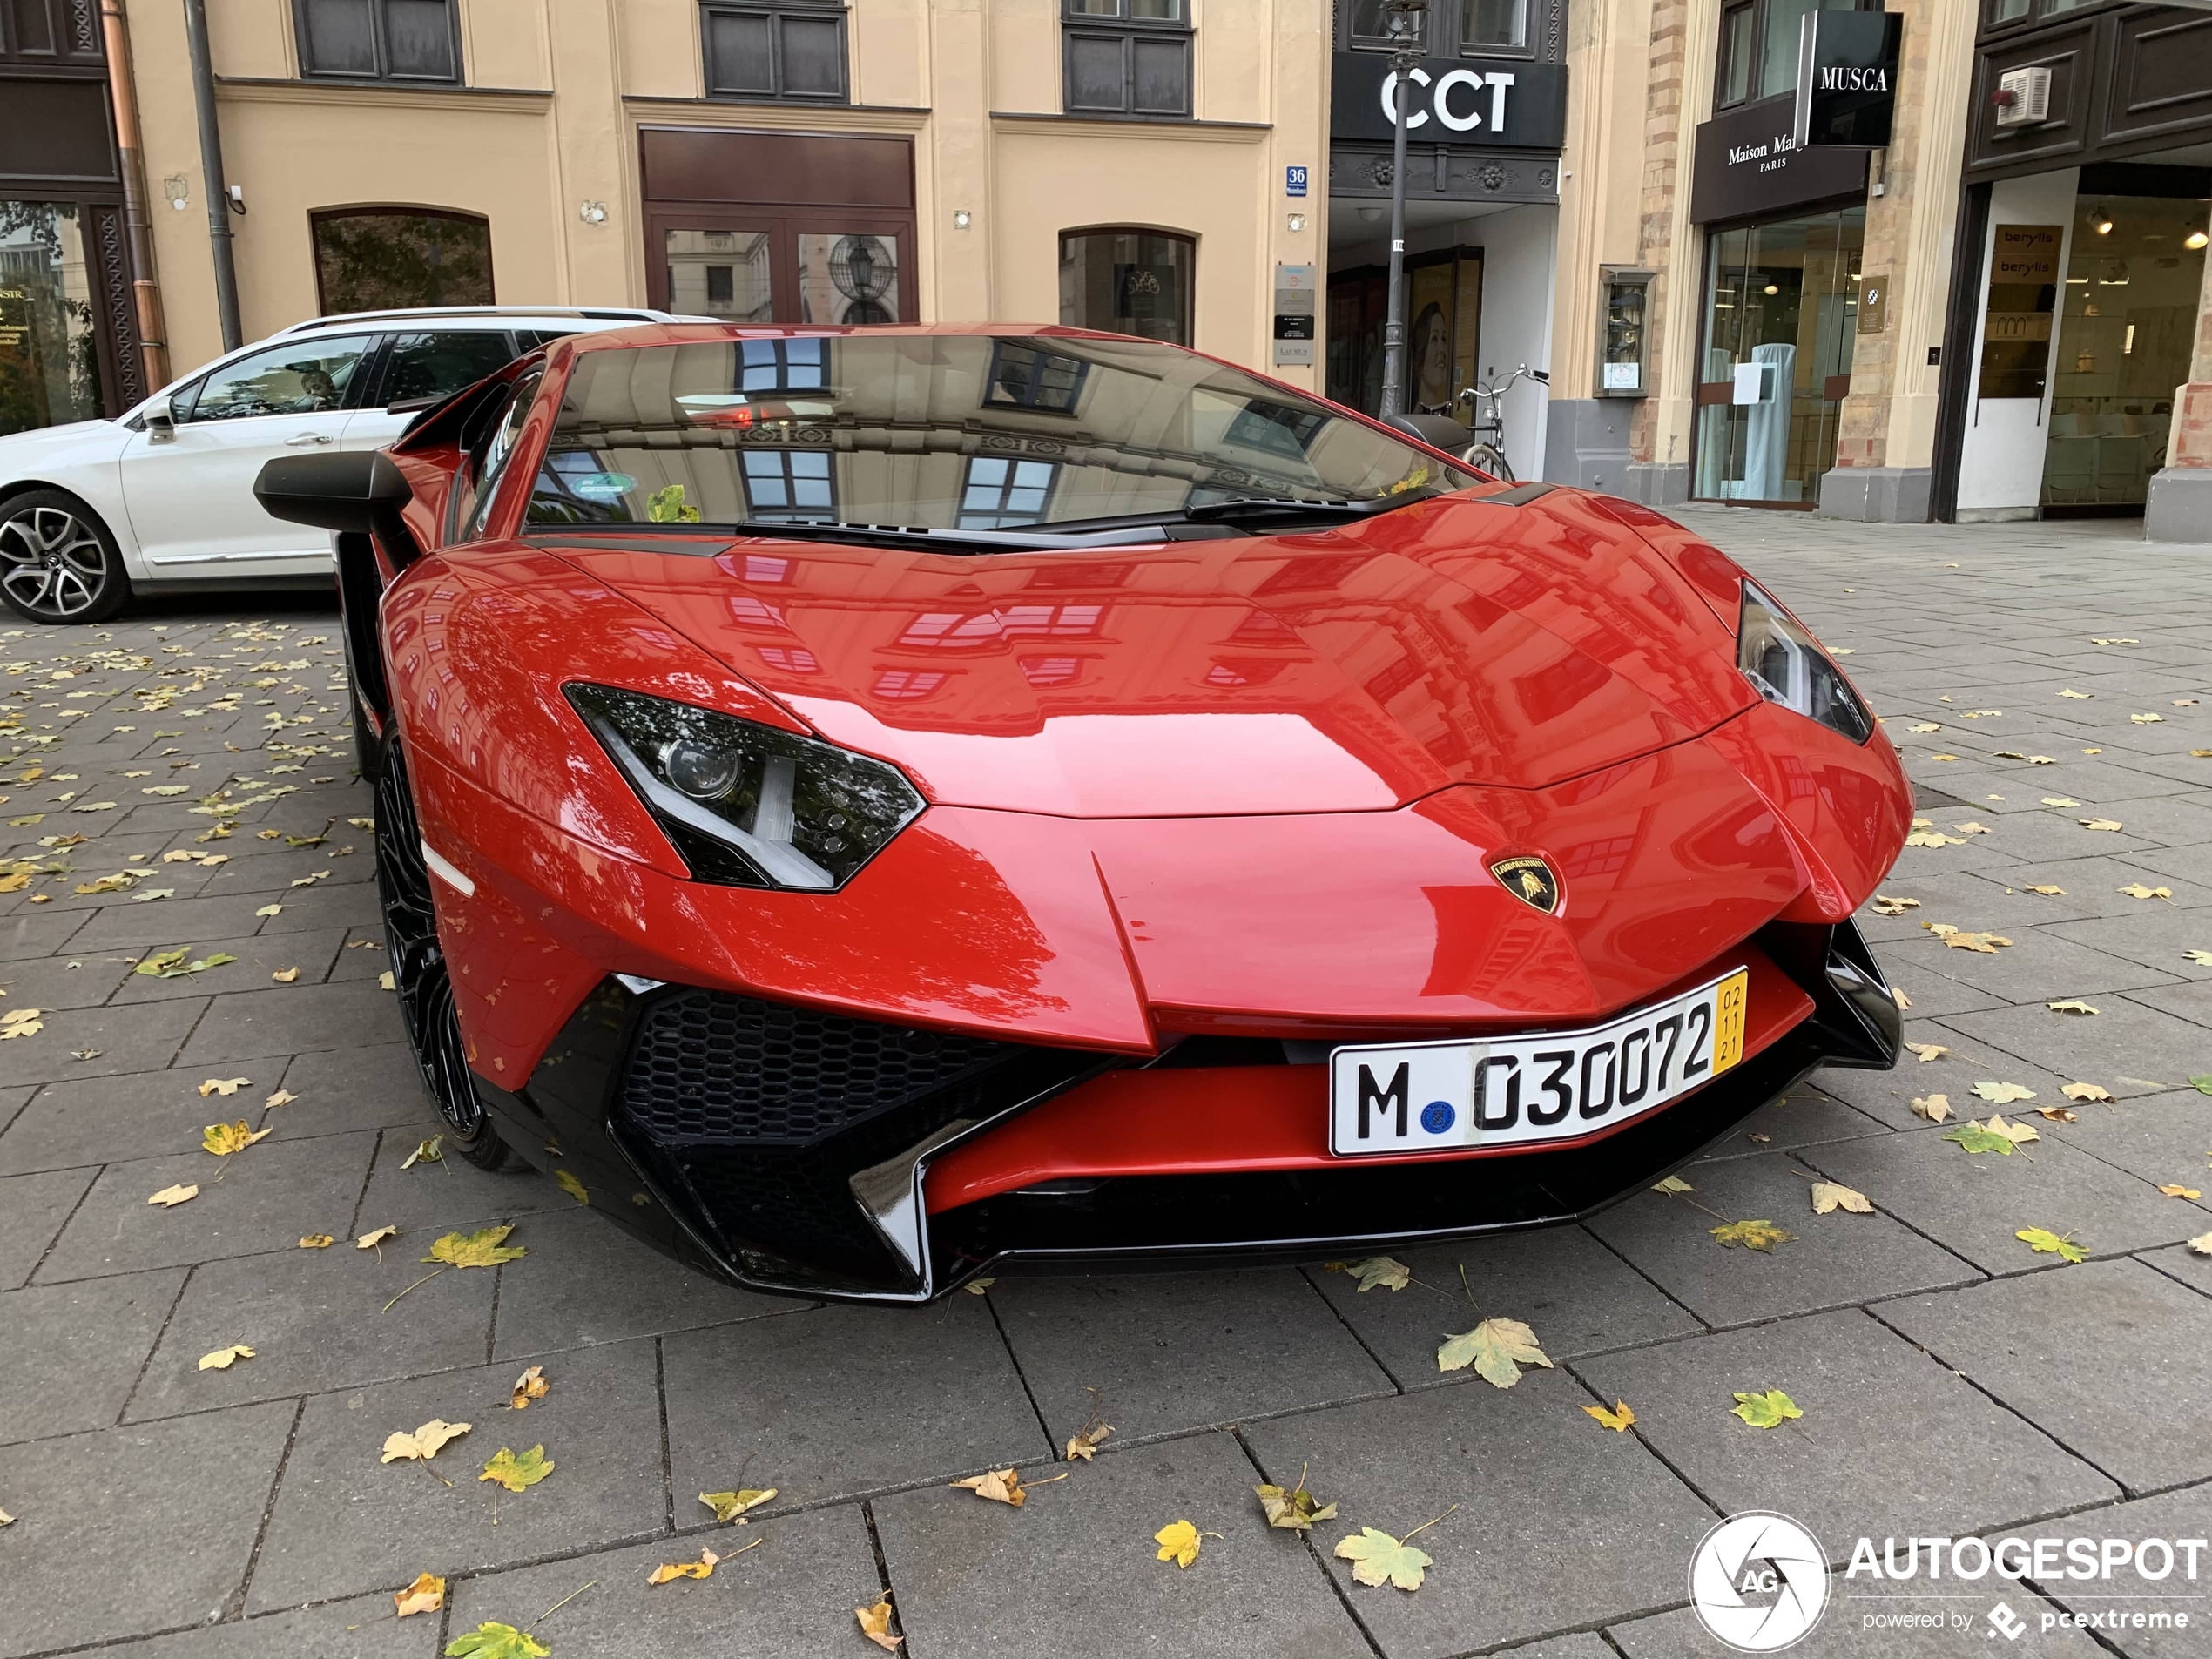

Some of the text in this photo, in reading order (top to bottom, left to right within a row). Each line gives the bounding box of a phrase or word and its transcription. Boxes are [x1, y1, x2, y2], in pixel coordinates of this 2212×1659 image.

[1819, 66, 1888, 91] MUSCA
[1381, 68, 1514, 132] CCT
[1728, 144, 1768, 165] Maison
[1759, 158, 1787, 172] PARIS
[1289, 169, 1305, 184] 36
[2005, 232, 2054, 248] berylls
[2001, 262, 2050, 278] berylls
[1495, 860, 1543, 875] LAMBORGHINI
[1723, 986, 1741, 1010] 02
[1723, 1011, 1738, 1035] 11
[1720, 1035, 1737, 1061] 21
[1358, 1001, 1712, 1139] M 030072
